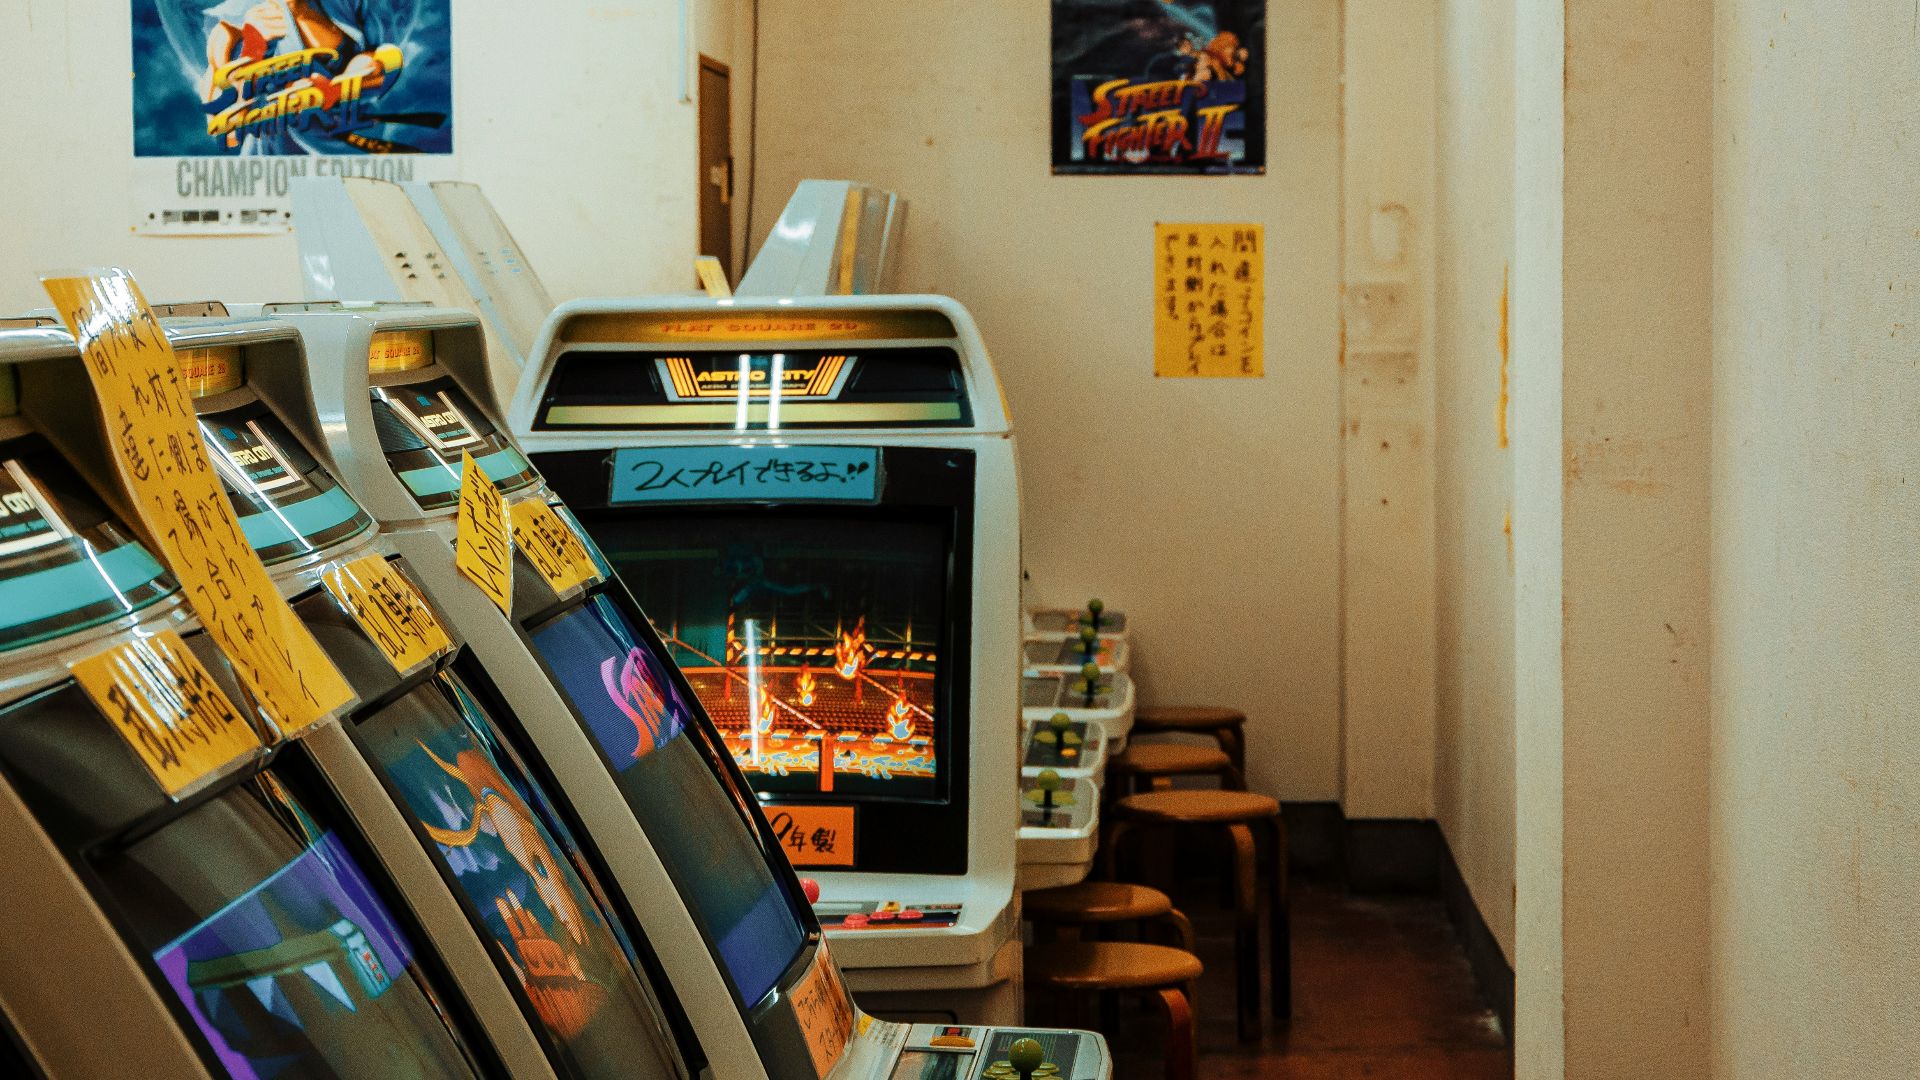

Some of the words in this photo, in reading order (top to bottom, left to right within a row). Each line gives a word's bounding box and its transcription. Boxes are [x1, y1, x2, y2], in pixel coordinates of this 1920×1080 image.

[202, 47, 340, 114] STREET
[1078, 78, 1208, 127] STREET
[207, 86, 336, 152] FIGHTER
[1082, 108, 1193, 159] FIGHTER
[1190, 103, 1240, 159] II
[727, 320, 816, 332] SQUARE
[697, 369, 766, 382] ASTO
